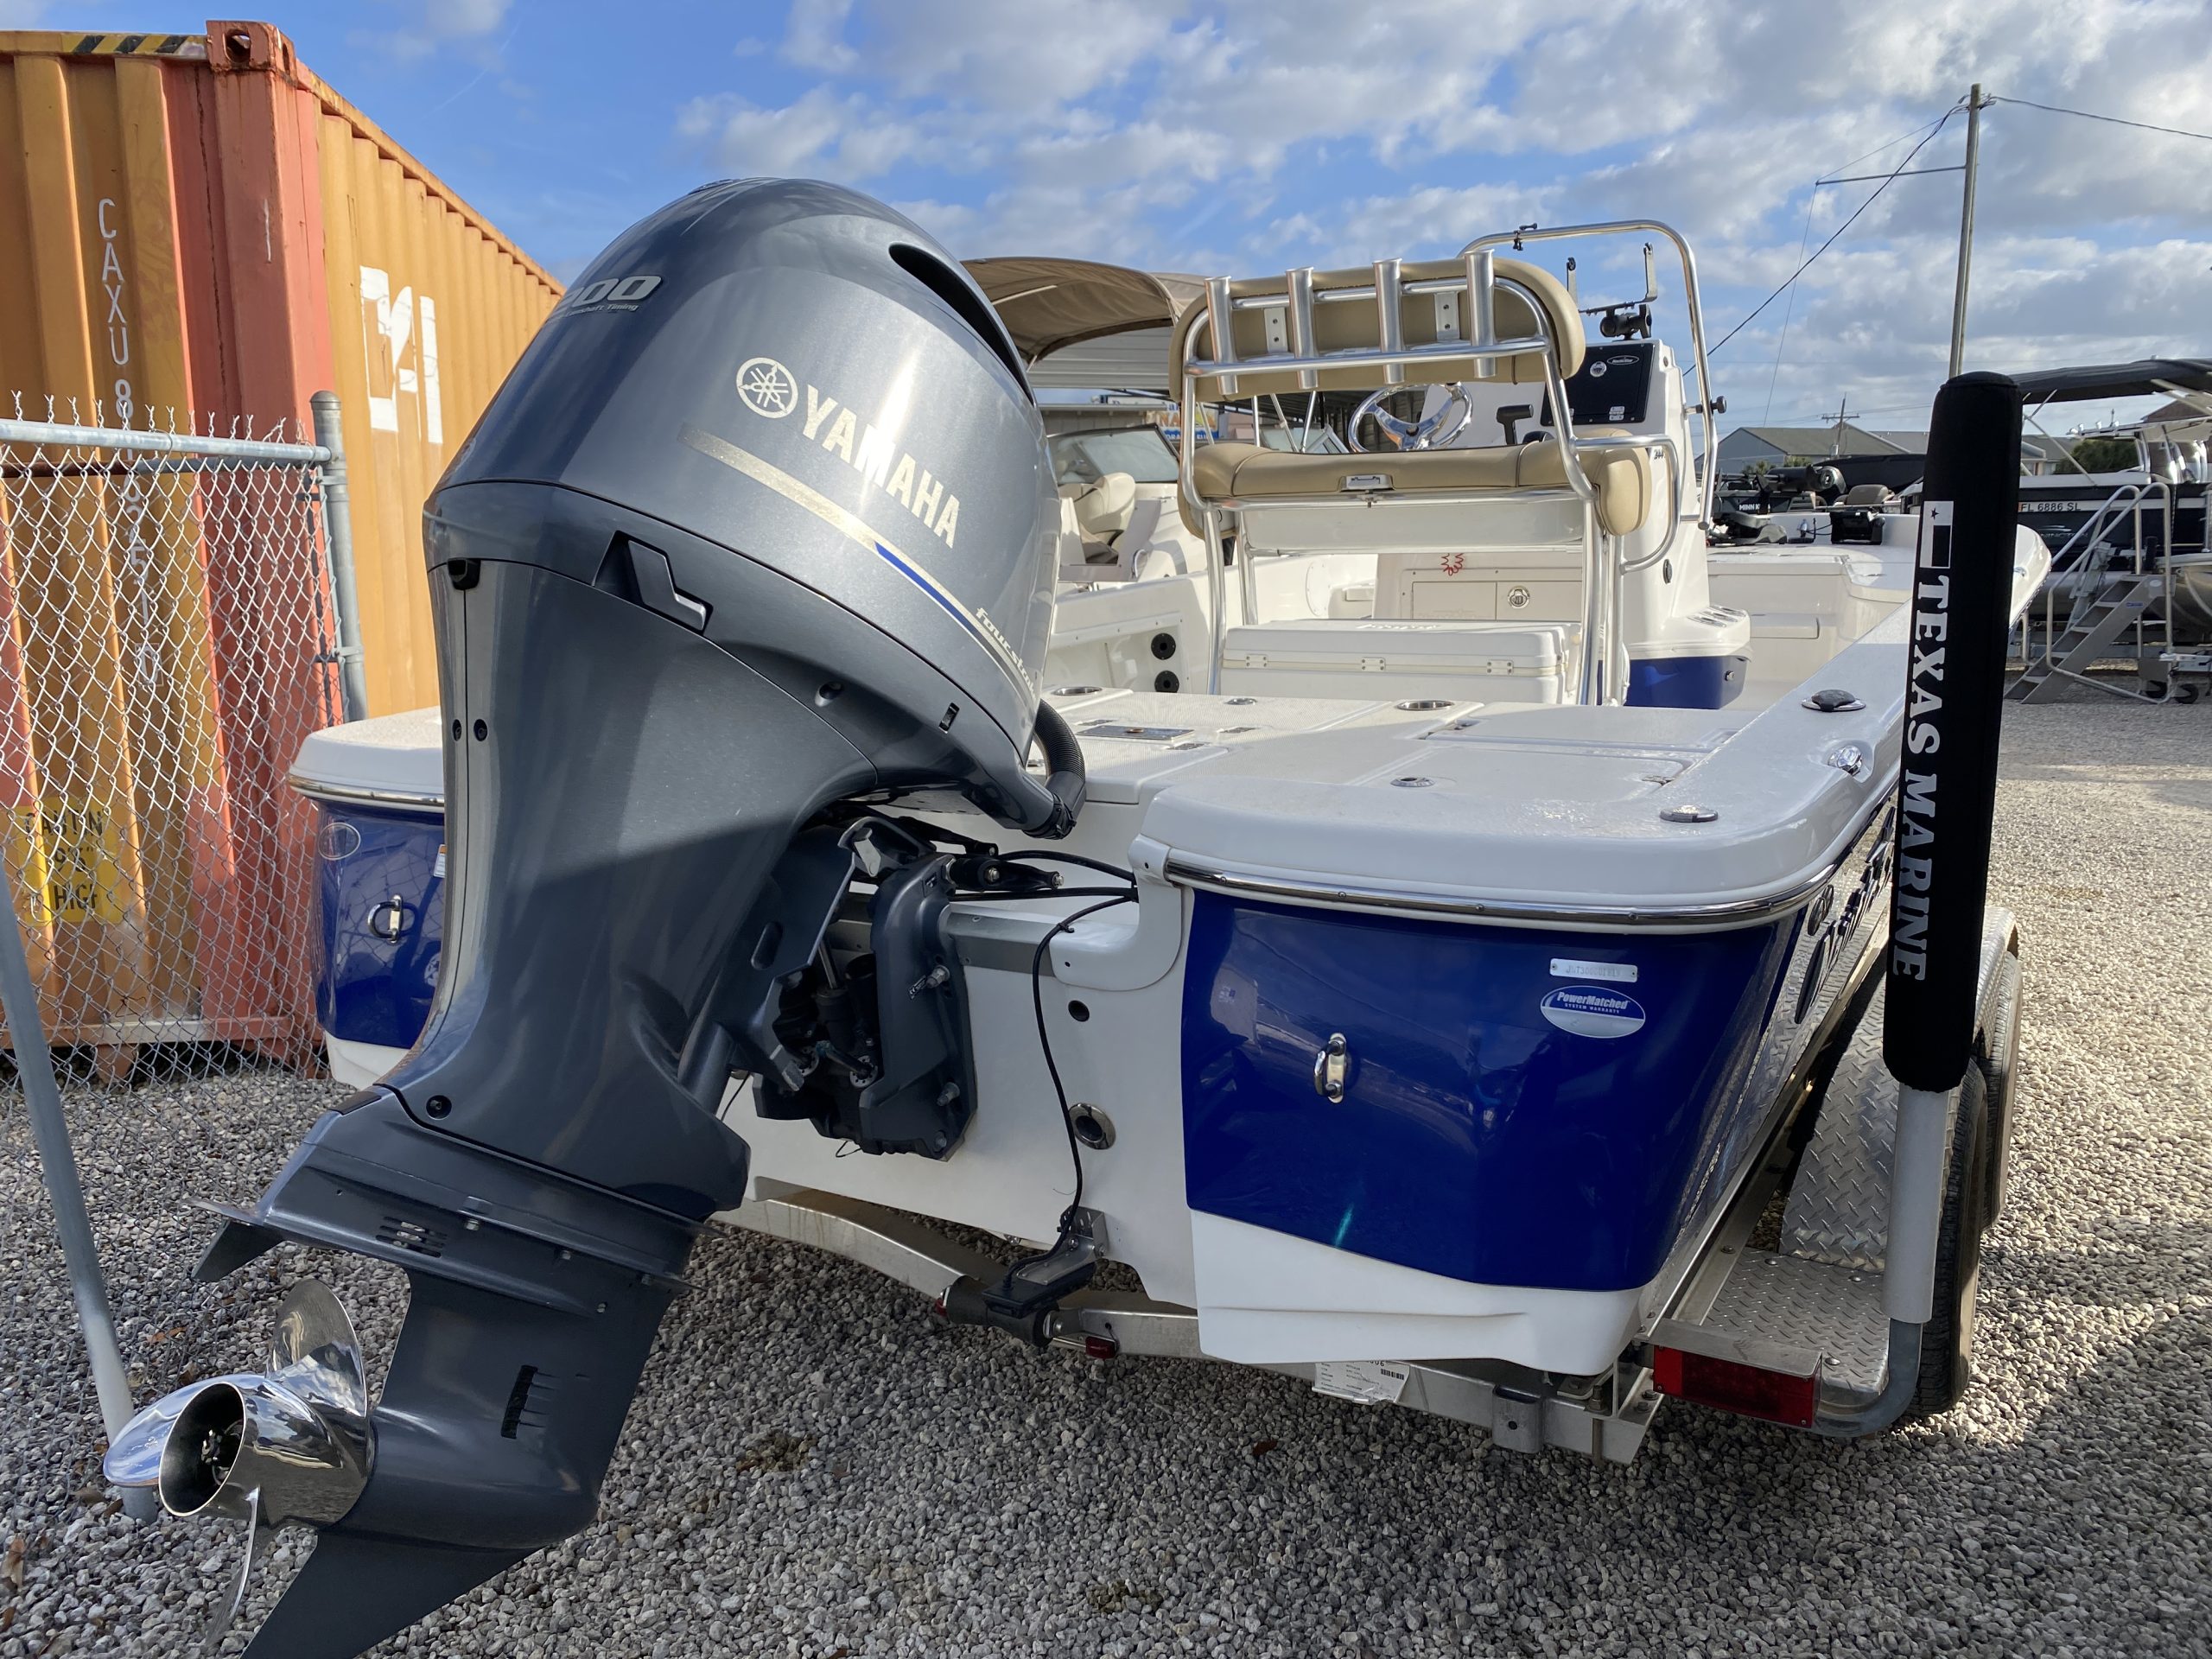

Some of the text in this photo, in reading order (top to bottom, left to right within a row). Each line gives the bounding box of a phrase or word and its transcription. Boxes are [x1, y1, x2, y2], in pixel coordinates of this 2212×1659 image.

[98, 198, 129, 365] CAXU
[607, 302, 639, 312] Timing
[802, 385, 961, 550] YAMAHA
[2020, 502, 2082, 512] FL 6886 SL
[1892, 575, 1950, 982] TEXAS MARINE
[1556, 991, 1629, 1010] PowerMatched
